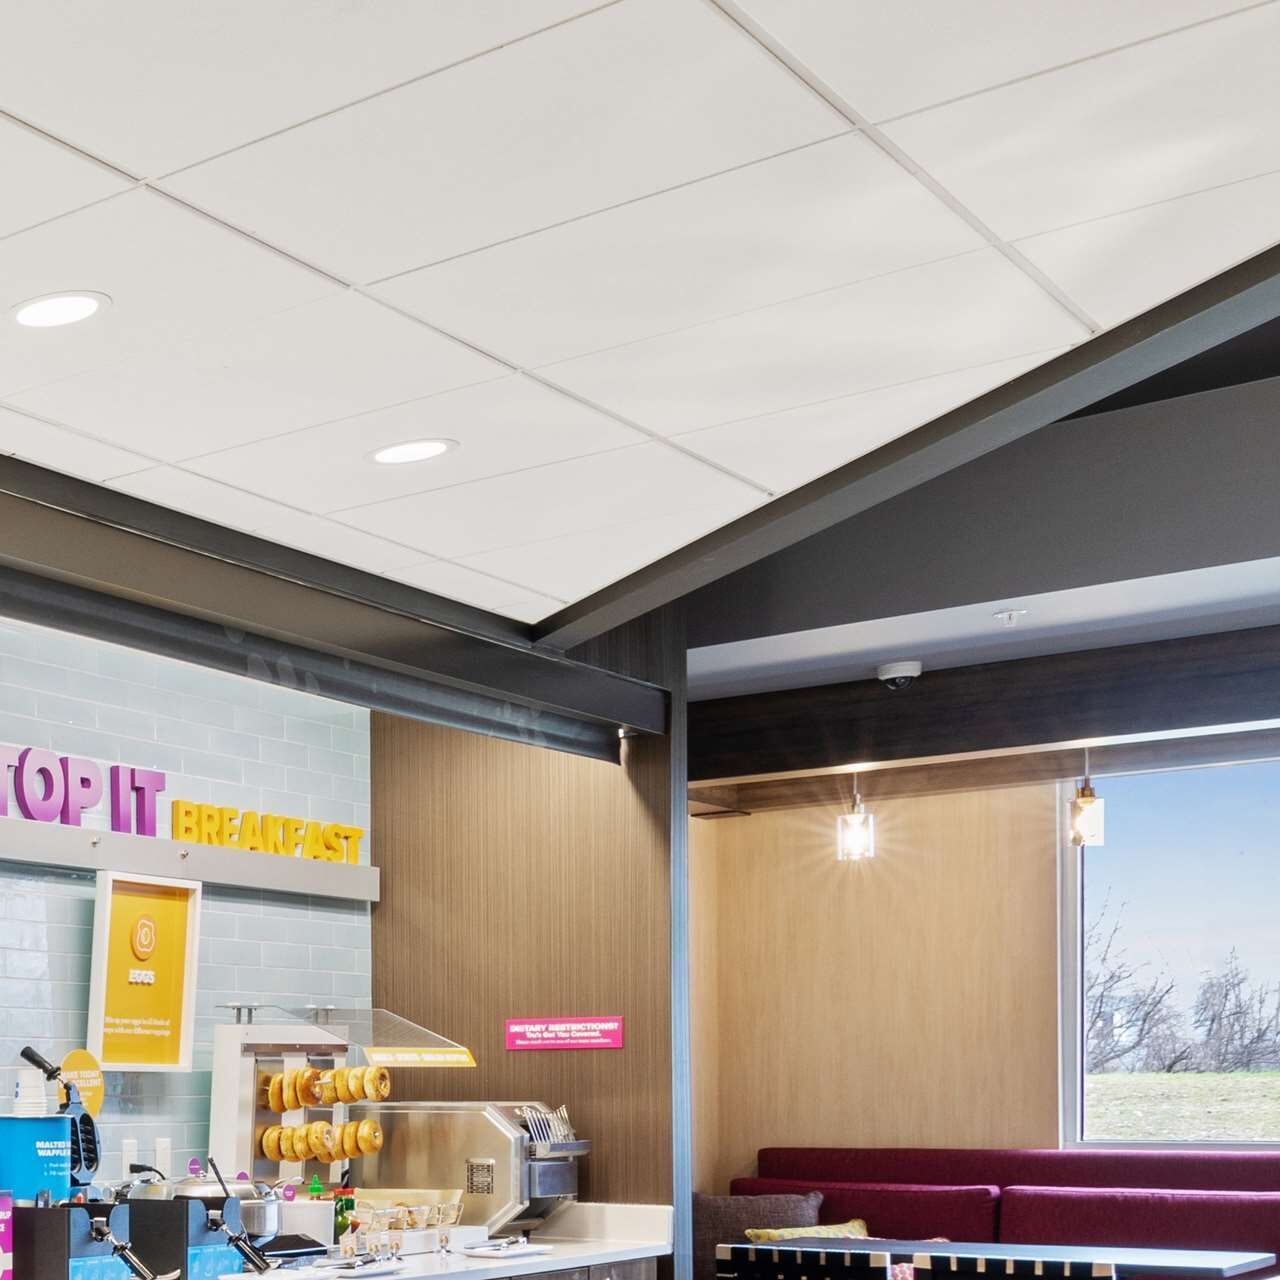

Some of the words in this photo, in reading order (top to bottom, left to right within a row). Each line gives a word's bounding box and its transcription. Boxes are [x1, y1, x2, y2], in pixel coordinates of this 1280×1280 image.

[110, 764, 166, 838] IT
[171, 799, 365, 865] BREAKFAST
[128, 969, 156, 984] EGGS
